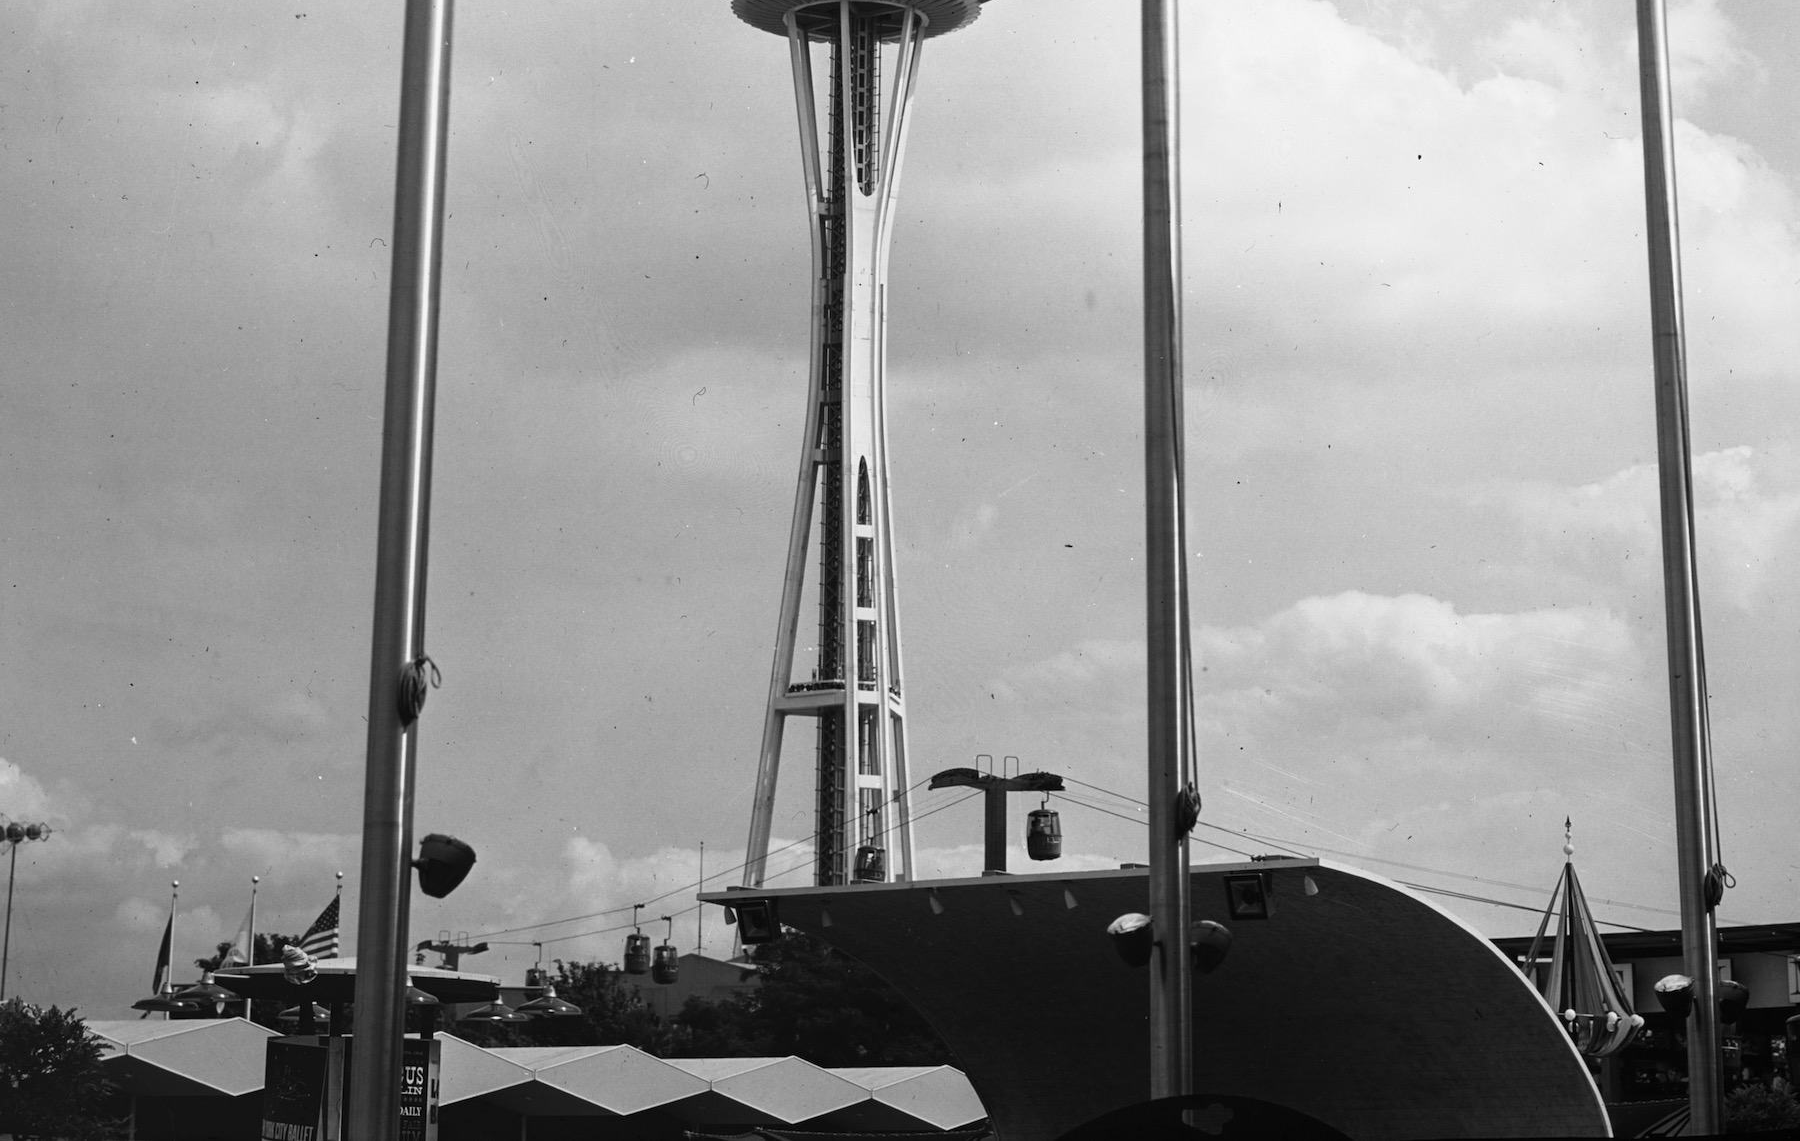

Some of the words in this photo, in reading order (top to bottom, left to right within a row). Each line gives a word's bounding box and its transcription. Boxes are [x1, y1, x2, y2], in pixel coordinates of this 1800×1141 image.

[401, 1066, 424, 1085] US
[275, 1122, 288, 1141] CITY
[288, 1124, 314, 1141] BALLET
